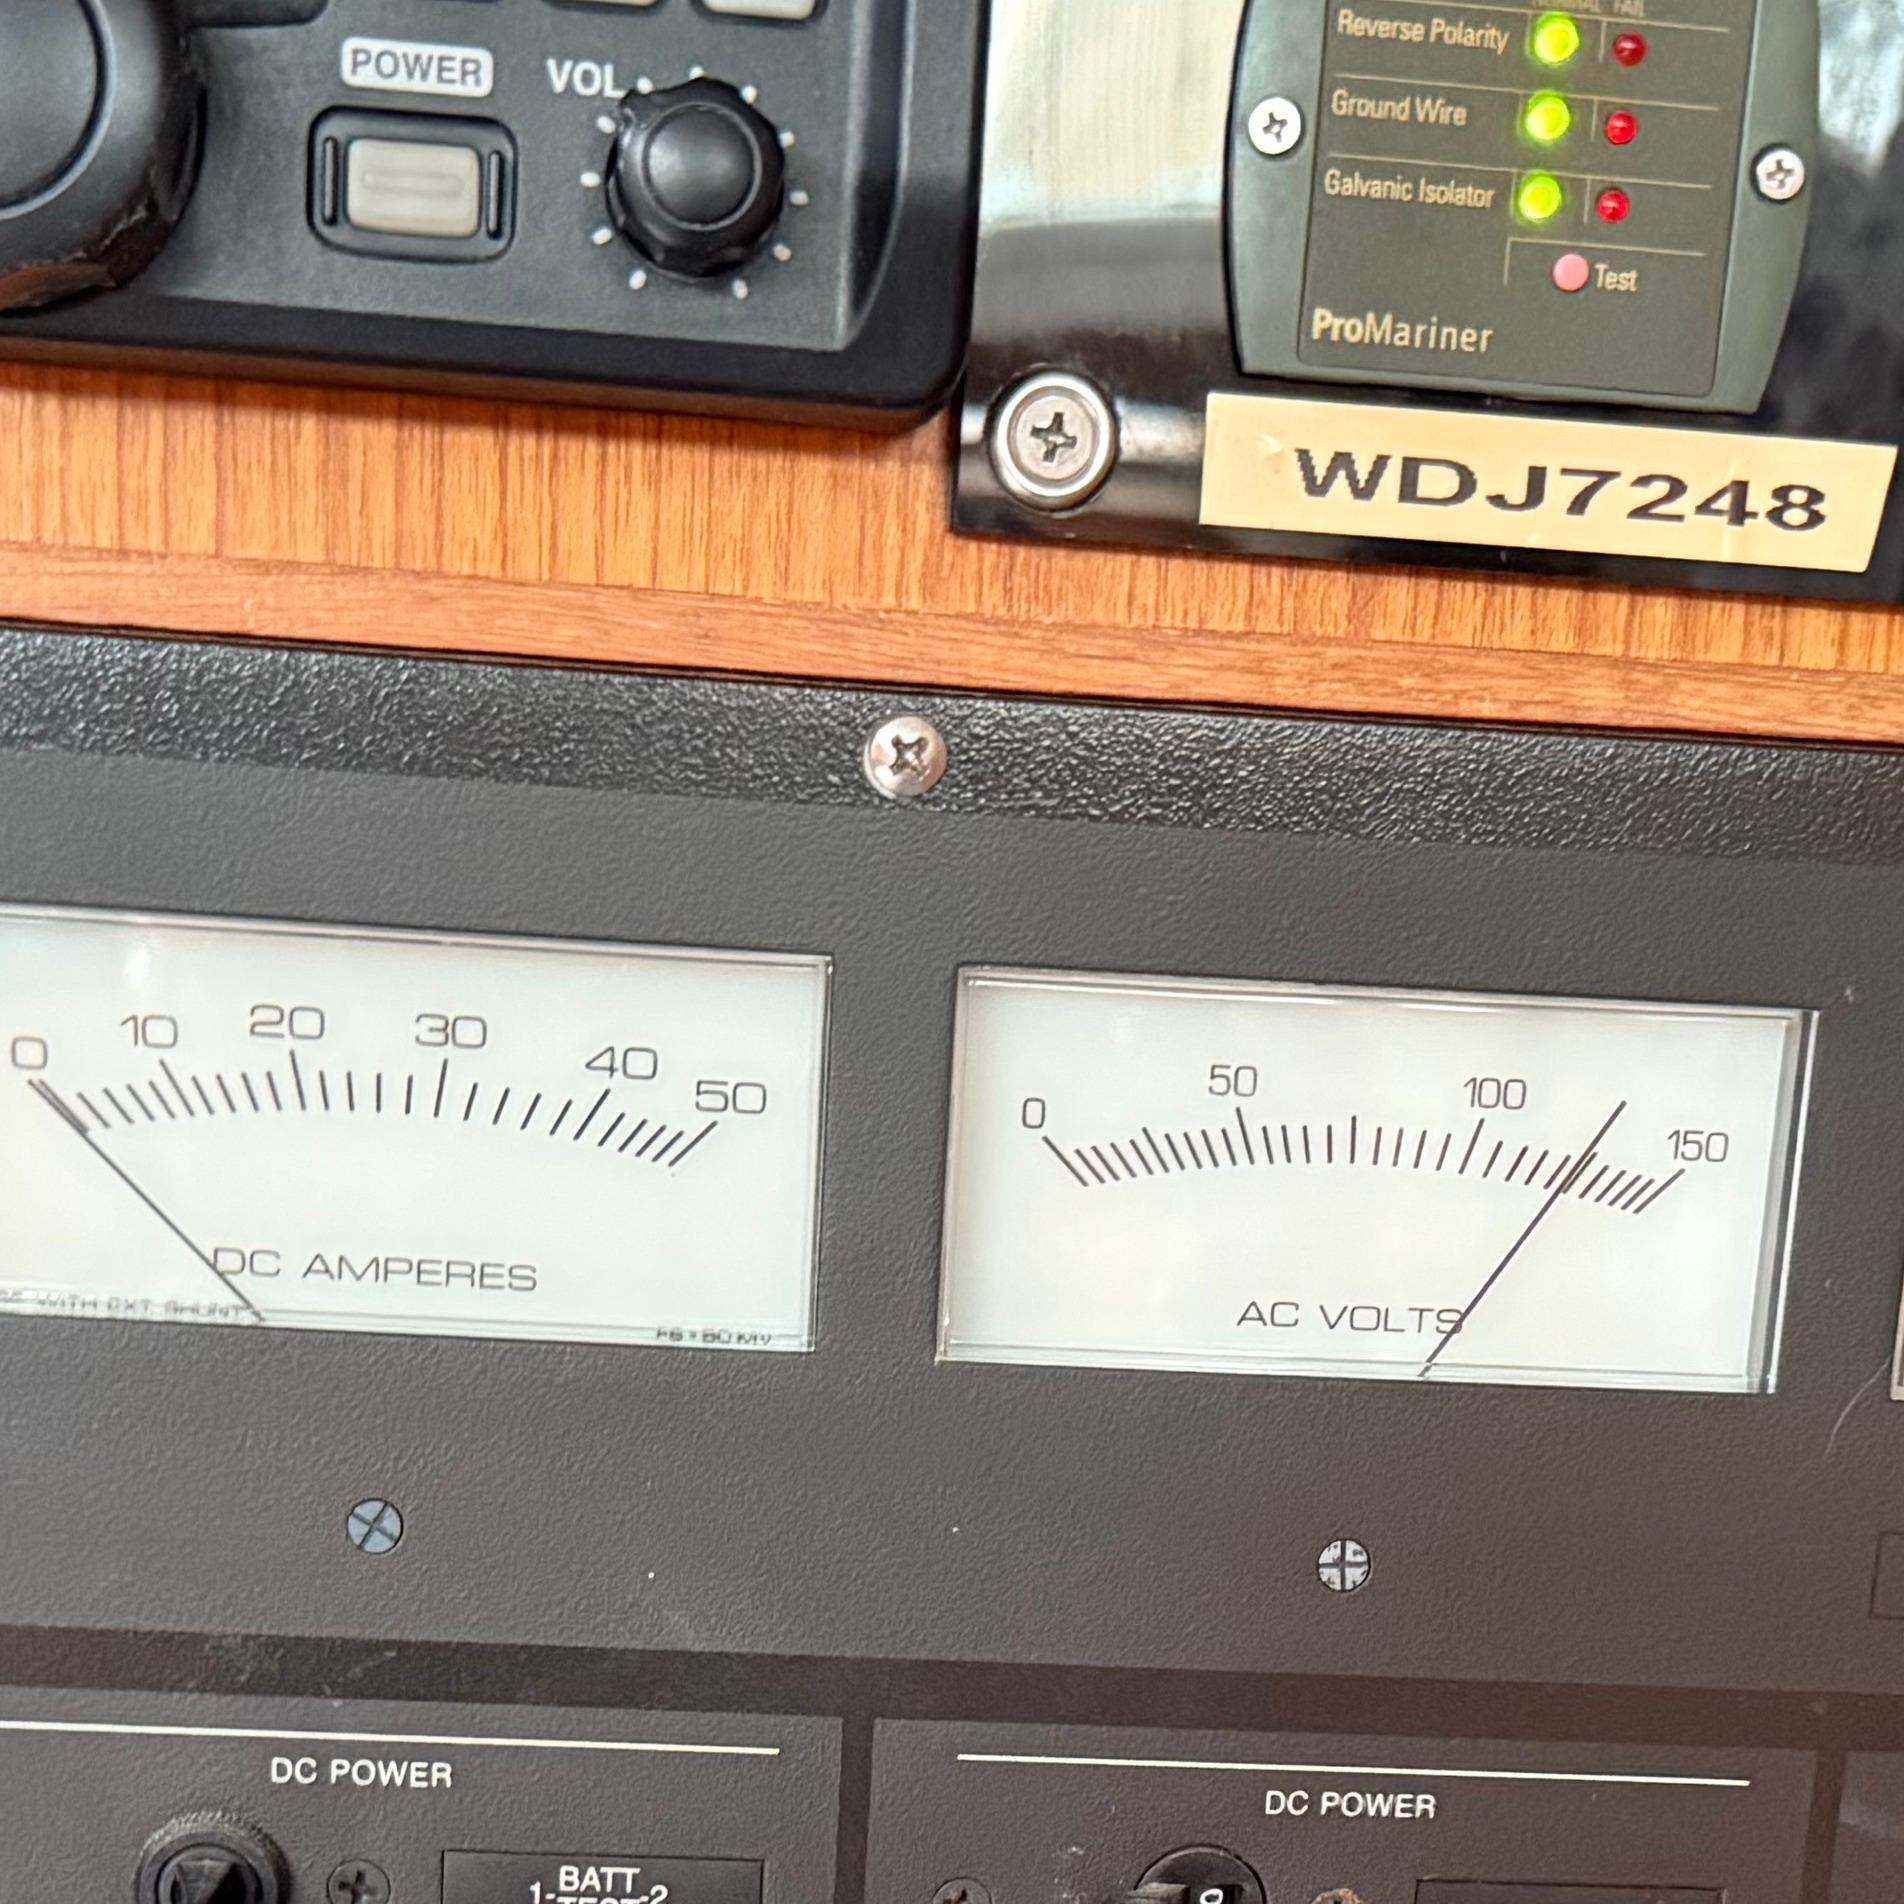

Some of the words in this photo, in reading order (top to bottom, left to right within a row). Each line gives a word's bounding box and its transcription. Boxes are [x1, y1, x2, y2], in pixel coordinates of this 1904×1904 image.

[1337, 9, 1425, 42] Reverse
[1429, 18, 1510, 55] Polarity
[348, 46, 484, 90] POWER
[545, 59, 624, 98] VOL
[1331, 89, 1410, 122] Ground
[1416, 98, 1468, 127] Wire
[1325, 168, 1413, 202] Galvanic
[1419, 177, 1495, 209] Isolator
[1594, 264, 1637, 291] Test
[1311, 308, 1492, 354] ProMariner
[1295, 446, 1827, 532] WDJ7248
[120, 1014, 178, 1049] 10
[249, 1005, 325, 1040] 20
[414, 1014, 487, 1049] 30
[585, 1048, 658, 1080] 40
[696, 1080, 767, 1115] 50
[1209, 1066, 1257, 1098] 50
[1463, 1078, 1526, 1110] 100
[1666, 1130, 1728, 1163] 150
[212, 1247, 282, 1279] DC
[302, 1253, 537, 1292] AMPERES
[1236, 1302, 1299, 1327] AC
[1319, 1305, 1463, 1334] VOLTS
[270, 1758, 318, 1785] DC
[329, 1759, 454, 1789] POWER
[1263, 1790, 1309, 1817] DC
[1320, 1791, 1437, 1820] POWER
[558, 1865, 640, 1894] BATT
